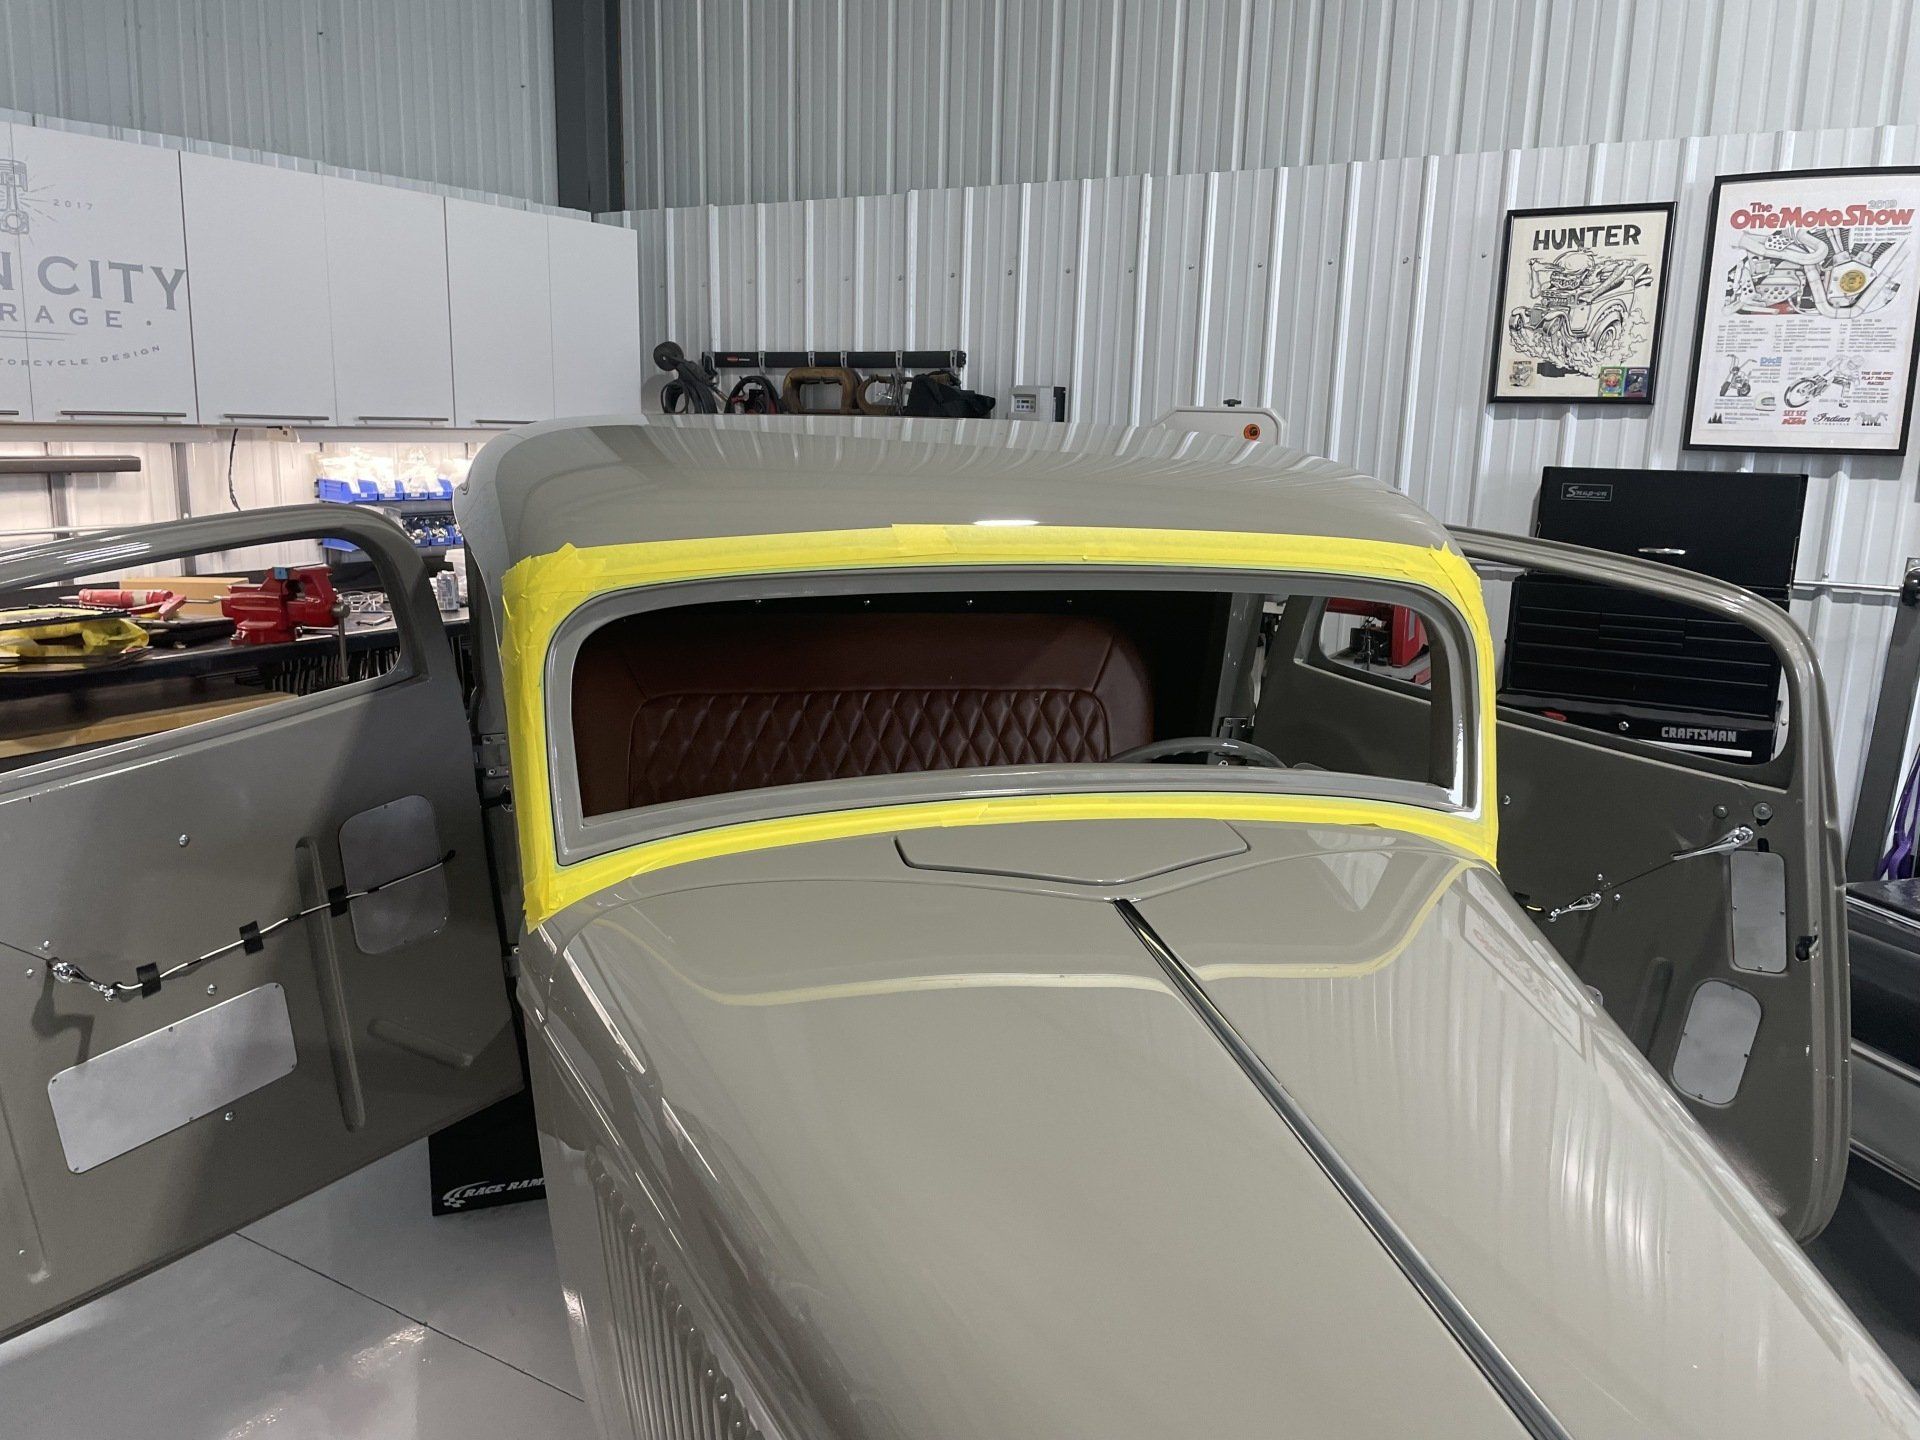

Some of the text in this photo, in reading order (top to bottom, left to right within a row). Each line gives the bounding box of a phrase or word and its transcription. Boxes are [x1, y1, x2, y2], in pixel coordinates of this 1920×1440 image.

[53, 198, 94, 210] 2017
[1750, 202, 1773, 213] The
[1533, 224, 1641, 250] HUNTER
[37, 255, 186, 311] CITY
[0, 345, 160, 367] ORCYCLE DESIGN
[1813, 413, 1850, 422] Indian
[1661, 727, 1737, 742] CRAFTSMAN
[463, 1184, 505, 1198] RACE
